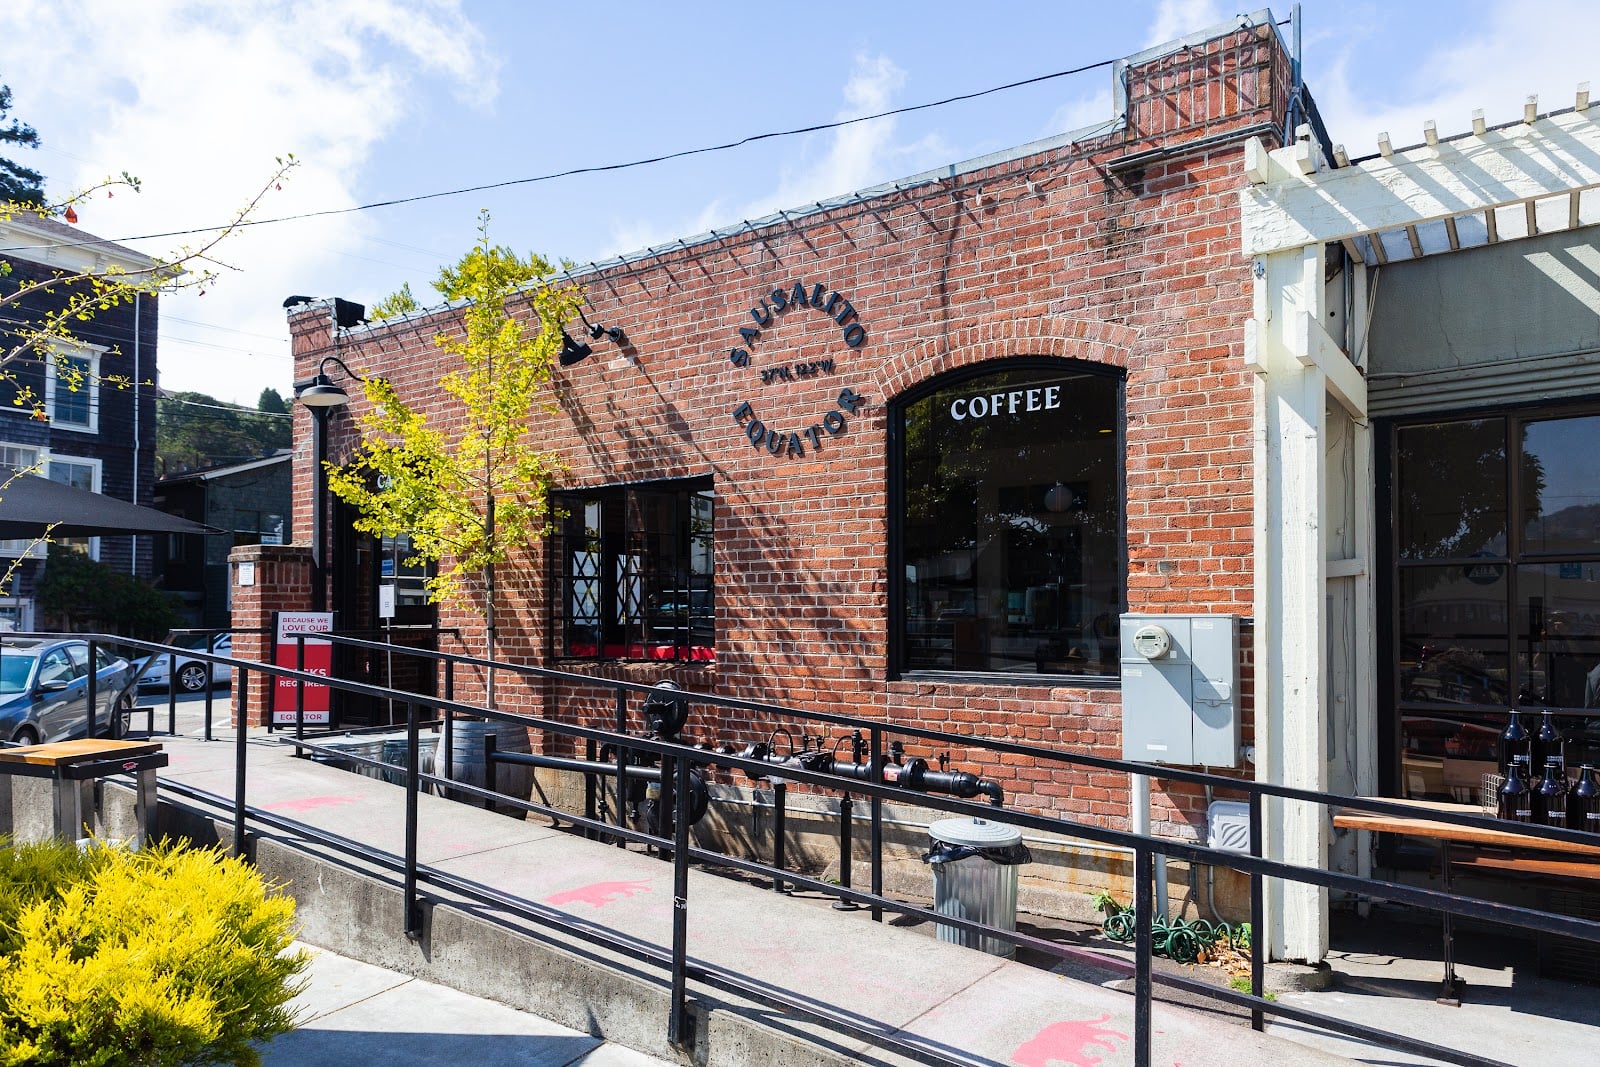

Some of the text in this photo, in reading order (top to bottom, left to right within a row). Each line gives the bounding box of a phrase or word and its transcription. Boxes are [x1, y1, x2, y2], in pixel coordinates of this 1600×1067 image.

[730, 282, 865, 367] SAUSALITO
[732, 388, 861, 457] EQUATOR
[950, 385, 1061, 421] COFFEE
[308, 624, 329, 632] OUR
